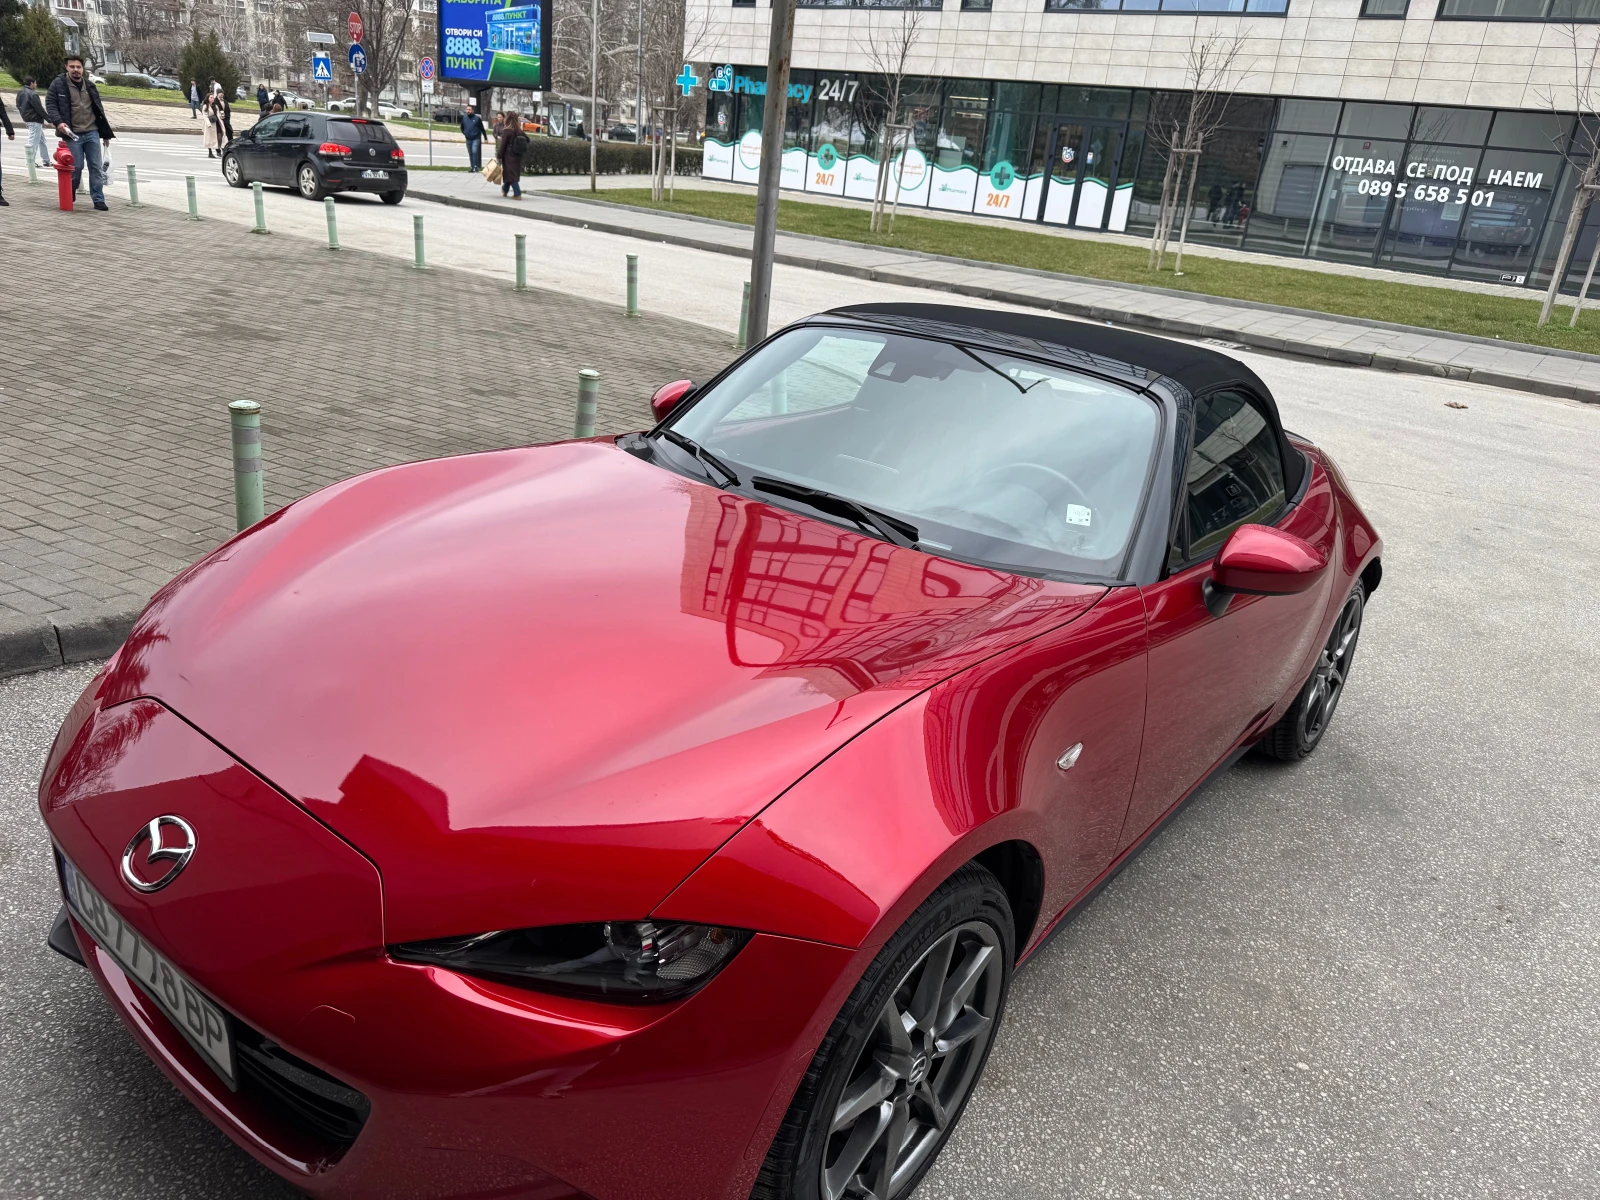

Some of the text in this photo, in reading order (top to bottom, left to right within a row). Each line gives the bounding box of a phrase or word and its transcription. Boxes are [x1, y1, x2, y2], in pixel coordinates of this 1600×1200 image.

[350, 22, 362, 34] STOP
[445, 28, 483, 37] ОТВОРИ СИ
[445, 37, 484, 56] 8888.
[446, 56, 484, 70] ПУНКТ
[818, 79, 859, 102] 24/7
[815, 172, 835, 187] 24/7
[1332, 156, 1396, 176] ОТДАВА
[1406, 162, 1427, 179] СЕ
[1432, 164, 1474, 186] ПОД
[1486, 169, 1544, 189] НАЕМ
[986, 193, 1011, 208] 24/7
[1413, 184, 1451, 203] 658
